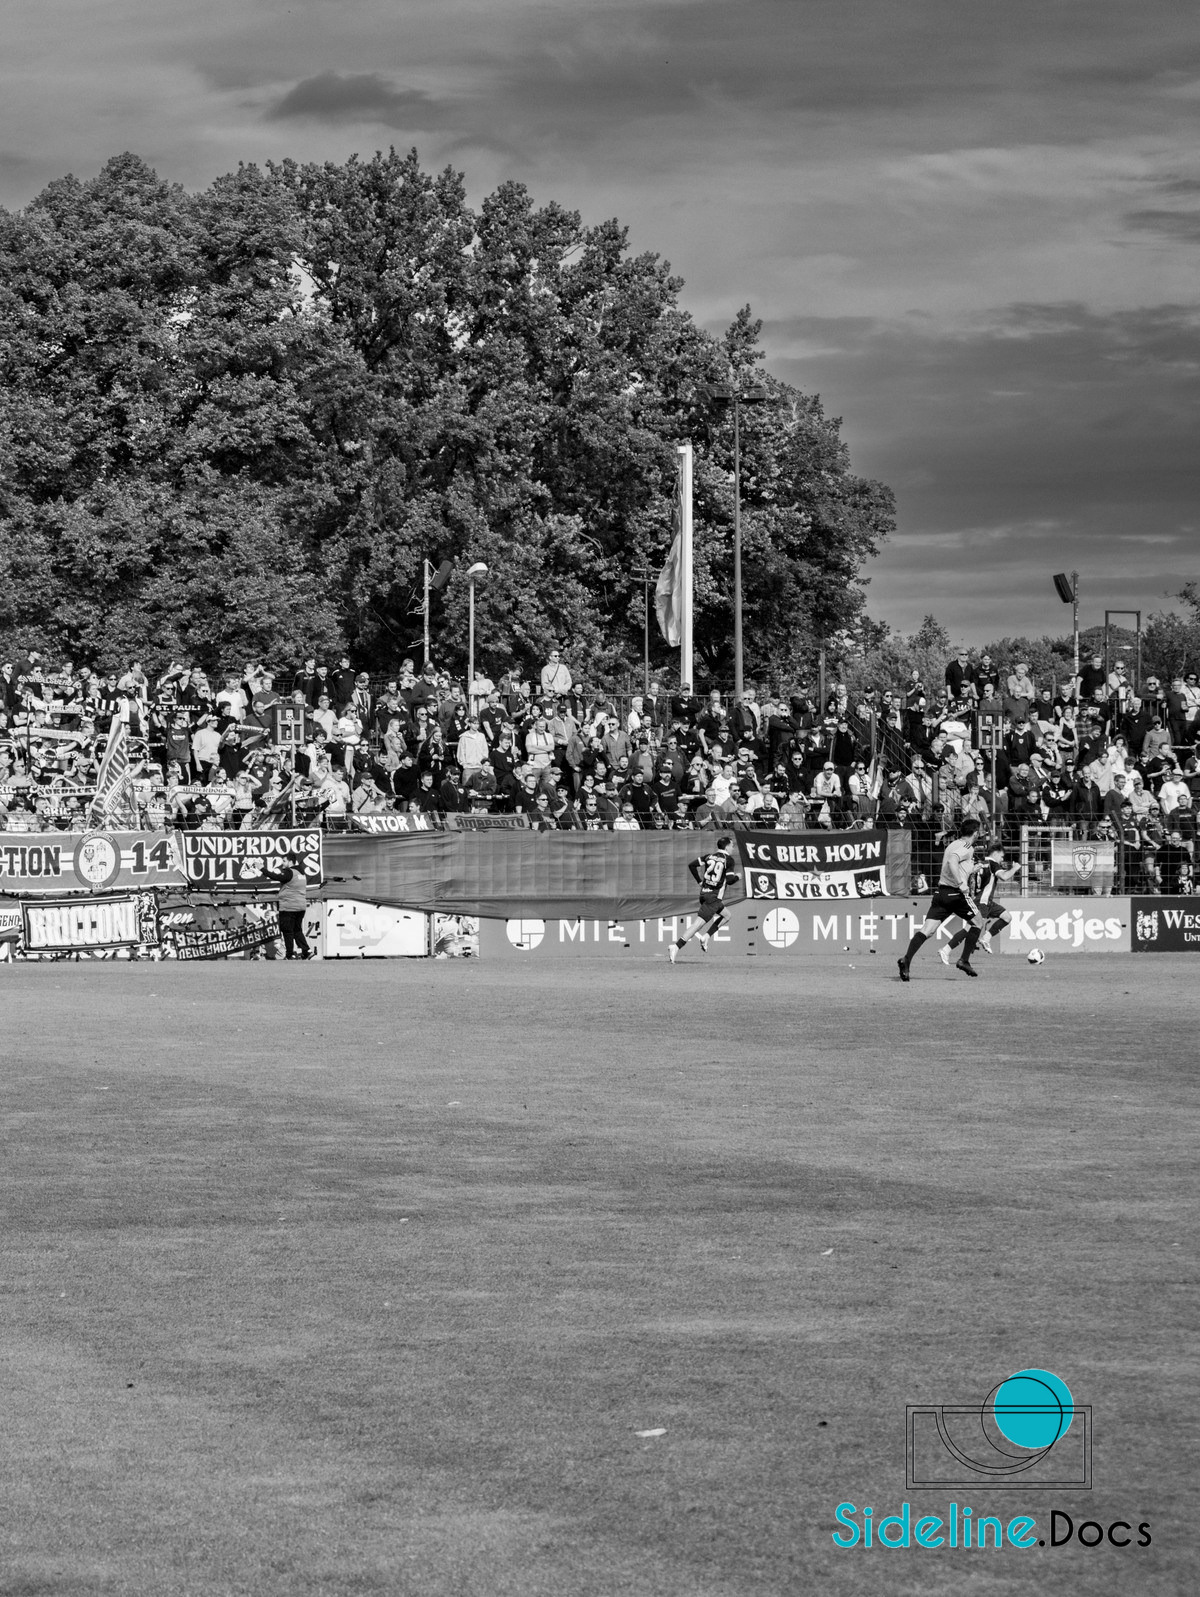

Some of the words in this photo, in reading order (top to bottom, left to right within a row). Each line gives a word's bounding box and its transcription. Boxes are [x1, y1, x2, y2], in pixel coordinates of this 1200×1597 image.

[415, 814, 432, 831] M
[185, 834, 320, 856] UNDERDOGS
[745, 842, 771, 861] FC
[776, 846, 820, 863] BIER
[824, 841, 882, 863] HOL'N
[129, 839, 173, 875] 14
[704, 859, 724, 882] 29
[784, 882, 823, 898] SVB
[826, 882, 850, 898] 03
[813, 914, 975, 940] MIETHK
[1008, 909, 1123, 947] Katjes
